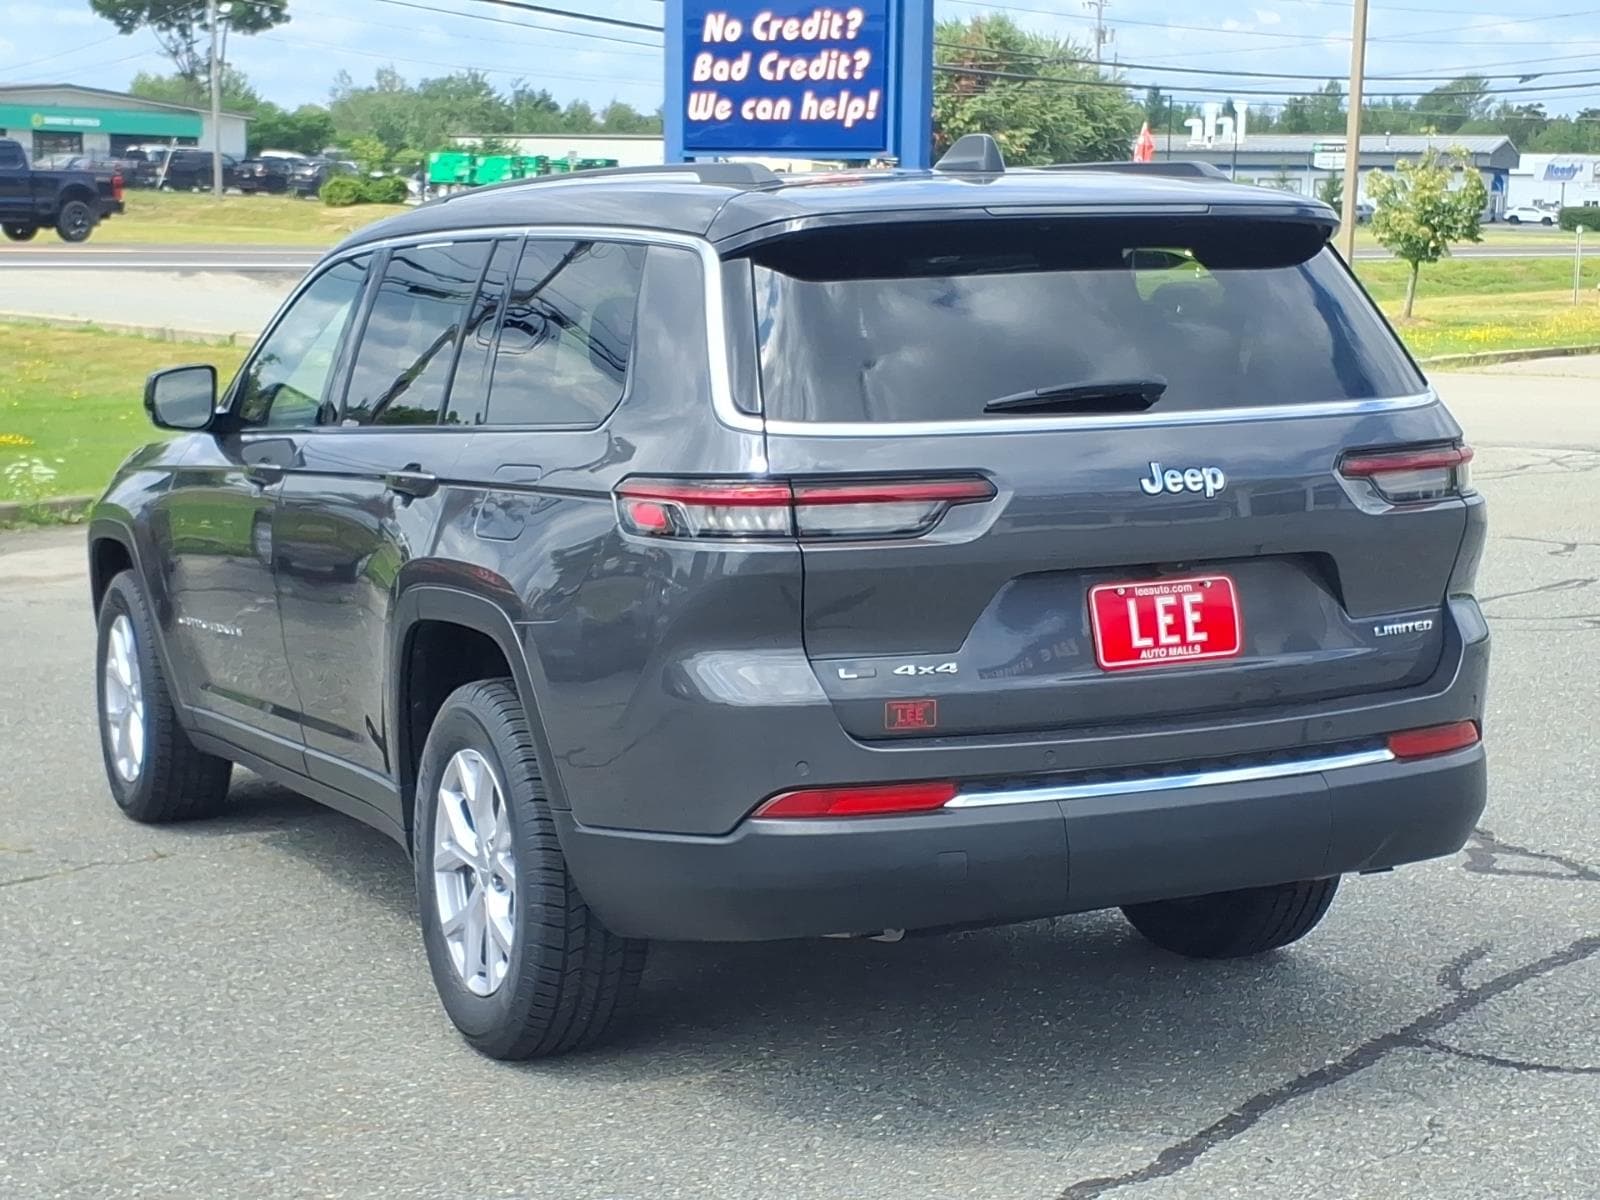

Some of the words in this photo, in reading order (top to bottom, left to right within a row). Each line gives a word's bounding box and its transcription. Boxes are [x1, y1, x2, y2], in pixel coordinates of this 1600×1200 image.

[702, 12, 743, 43] No
[752, 8, 864, 42] Credit?
[692, 51, 751, 82] Bad
[758, 48, 871, 81] Credit?
[687, 91, 733, 121] We
[740, 98, 792, 121] can
[800, 89, 880, 128] help!
[1140, 462, 1225, 498] Jeep
[1134, 584, 1193, 596] leeauto.com
[1126, 593, 1209, 648] LEE
[1373, 620, 1433, 637] LIMITED
[1139, 648, 1167, 659] AUTO
[1168, 645, 1201, 656] MALLS
[893, 662, 958, 676] 4x4
[897, 707, 924, 723] LEE
